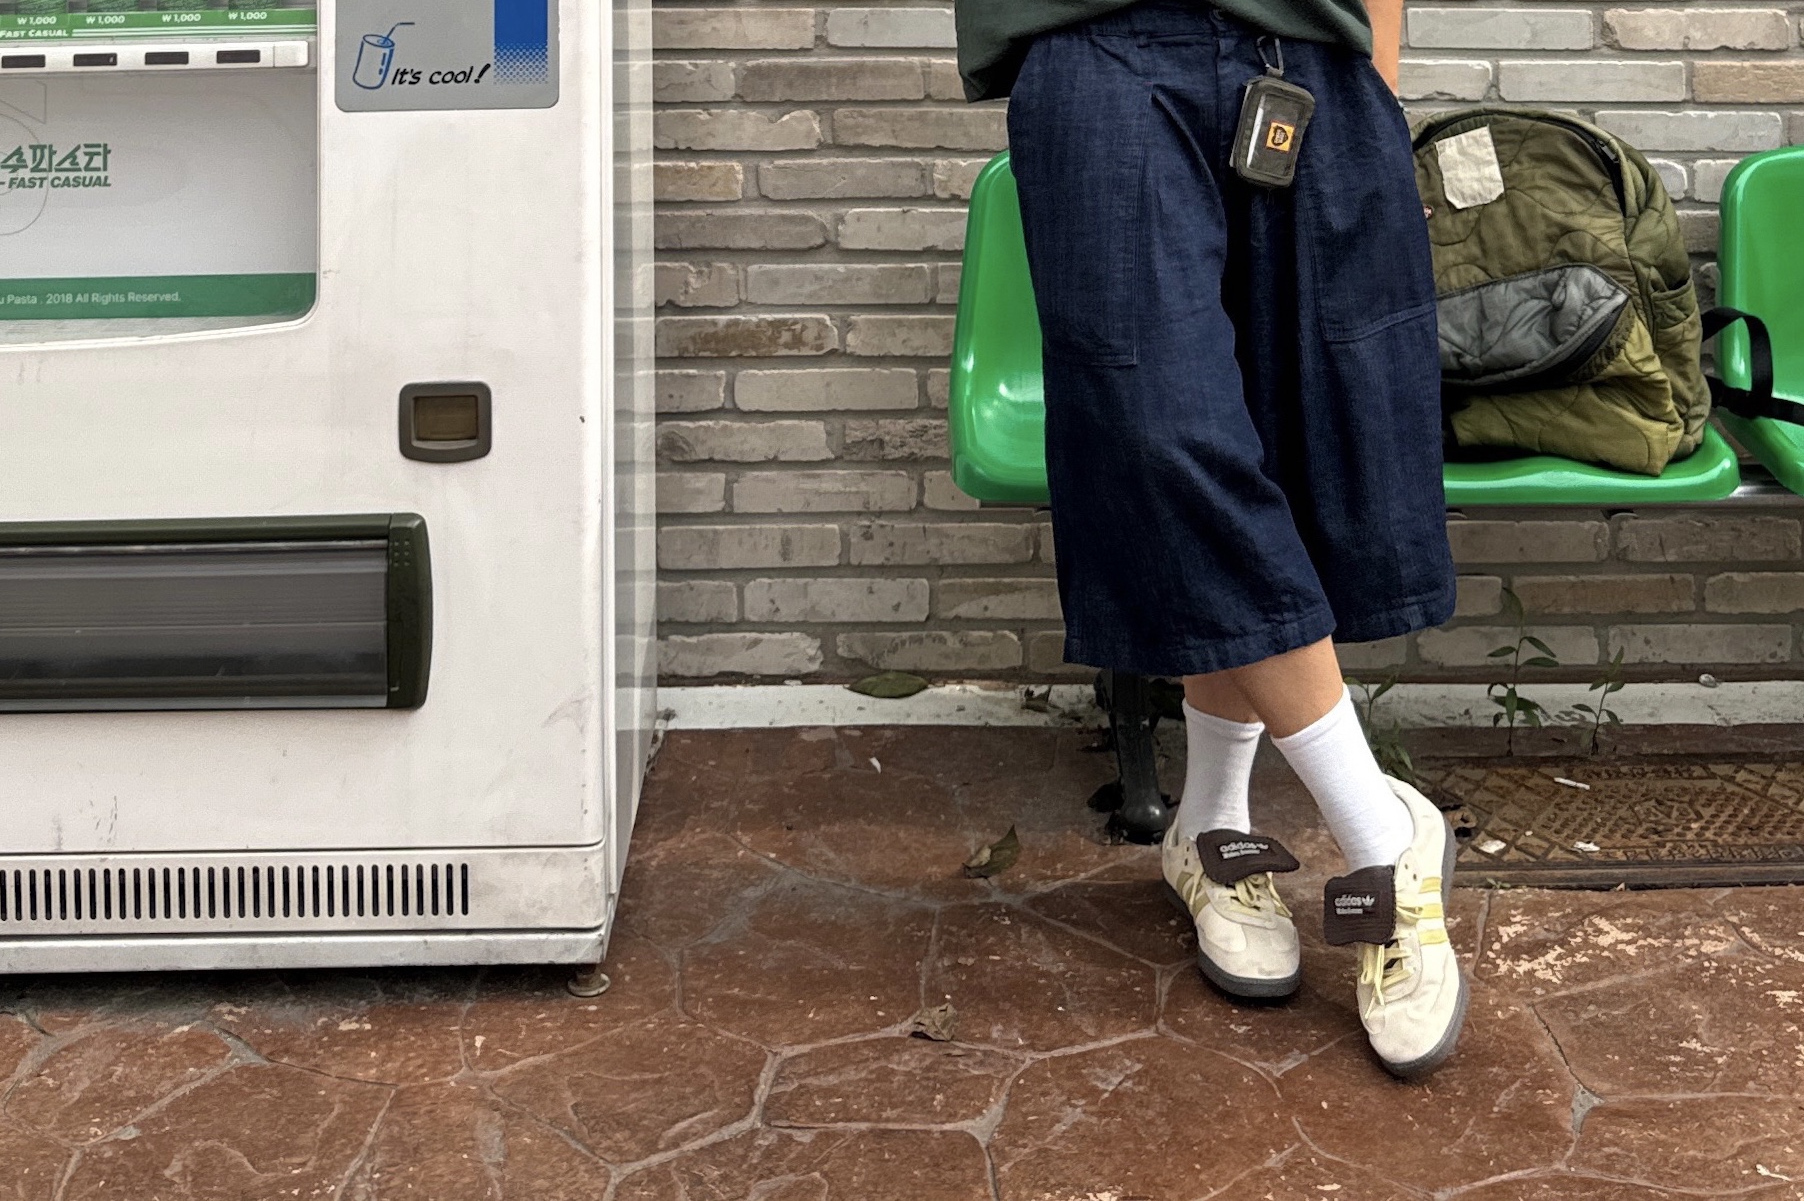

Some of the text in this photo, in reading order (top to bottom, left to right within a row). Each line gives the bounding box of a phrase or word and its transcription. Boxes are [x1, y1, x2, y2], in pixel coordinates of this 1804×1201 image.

[29, 17, 57, 25] 1,000
[98, 16, 125, 24] 1,000
[174, 14, 201, 23] 1,000
[240, 12, 268, 21] 1,000
[391, 68, 421, 85] It's
[8, 175, 112, 189] FAST CASUAL
[7, 294, 37, 304] Pasta
[46, 293, 73, 304] 2018
[76, 292, 89, 302] All
[91, 292, 125, 305] Rights
[127, 291, 181, 302] Reserved.
